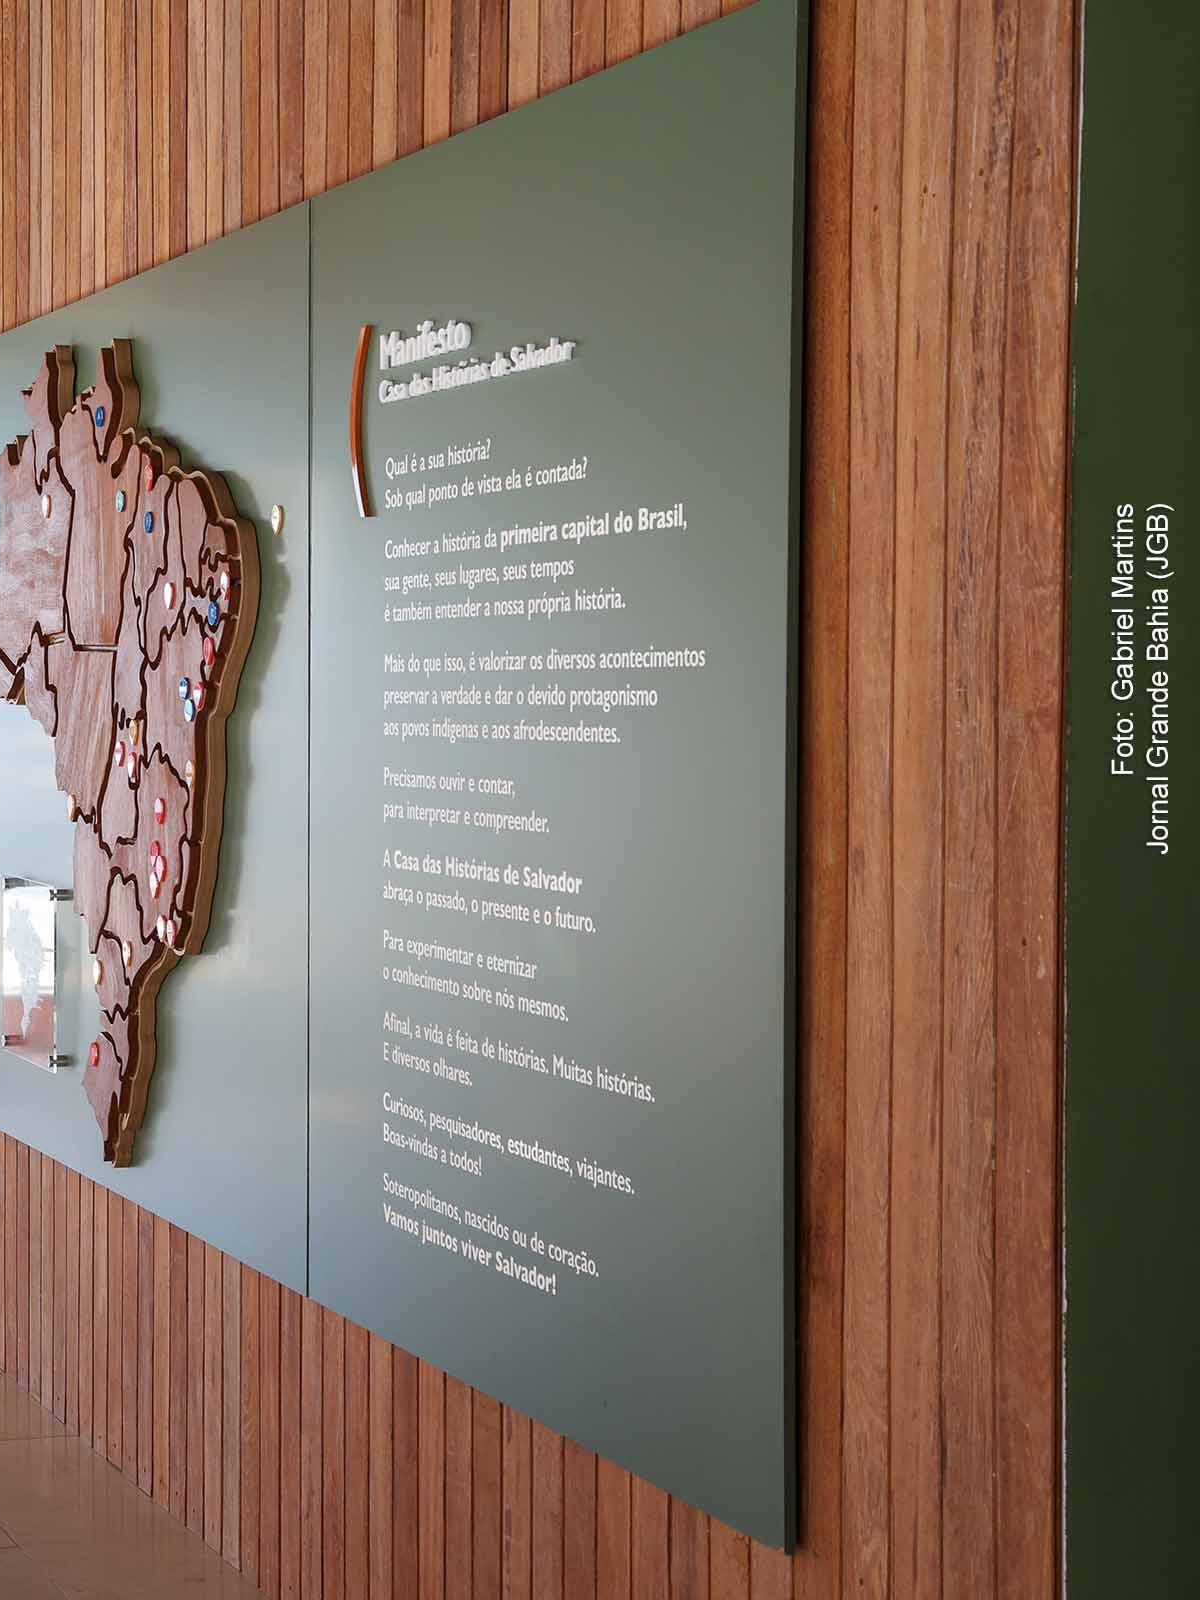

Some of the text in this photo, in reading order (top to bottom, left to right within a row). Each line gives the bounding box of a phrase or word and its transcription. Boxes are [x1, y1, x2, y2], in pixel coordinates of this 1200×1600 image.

[380, 320, 472, 370] Manifesto
[379, 337, 576, 403] Casa das Histórias de Salvador
[386, 438, 491, 480] Qual é a sua história?
[384, 457, 587, 511] Sob qual ponto de vista ela é contada?
[385, 503, 687, 559] Conhecer a história da primeira capital do Brasil,
[385, 561, 574, 595] sua gente, seus lugares, seus tempos
[385, 588, 626, 622] é também entender a nossa própria história.
[384, 646, 705, 676] Mais do que isso, é valorizar os diversos acontecimentos
[384, 684, 658, 713] preservar a verdade e dar o devido protagonismo
[384, 718, 620, 744] aos povos indígenas e aos afrodescendentes.
[384, 768, 515, 797] Precisamos ouvir e contar,
[384, 802, 549, 834] para interpretar e compreender.
[384, 848, 582, 895] A Casa das Histórias de Salvador
[383, 880, 596, 934] abraça o passado, o presente e o futuro.
[384, 930, 537, 979] Para experimentar e eternizar
[383, 967, 568, 1023] o conhecimento sobre nós mesmos.
[383, 1012, 655, 1103] Afinal, a vida é feita de histórias. Muitas histórias.
[384, 1042, 472, 1087] E diversos olhares.
[383, 1092, 635, 1195] Curiosos, pesquisadores, estudantes, viajantes.
[384, 1123, 482, 1177] Boas-vindas a todos!
[383, 1203, 556, 1295] Vamos juntos viver Salvador!
[384, 1173, 599, 1278] Soteropolitanos, nascidos ou de coração.
